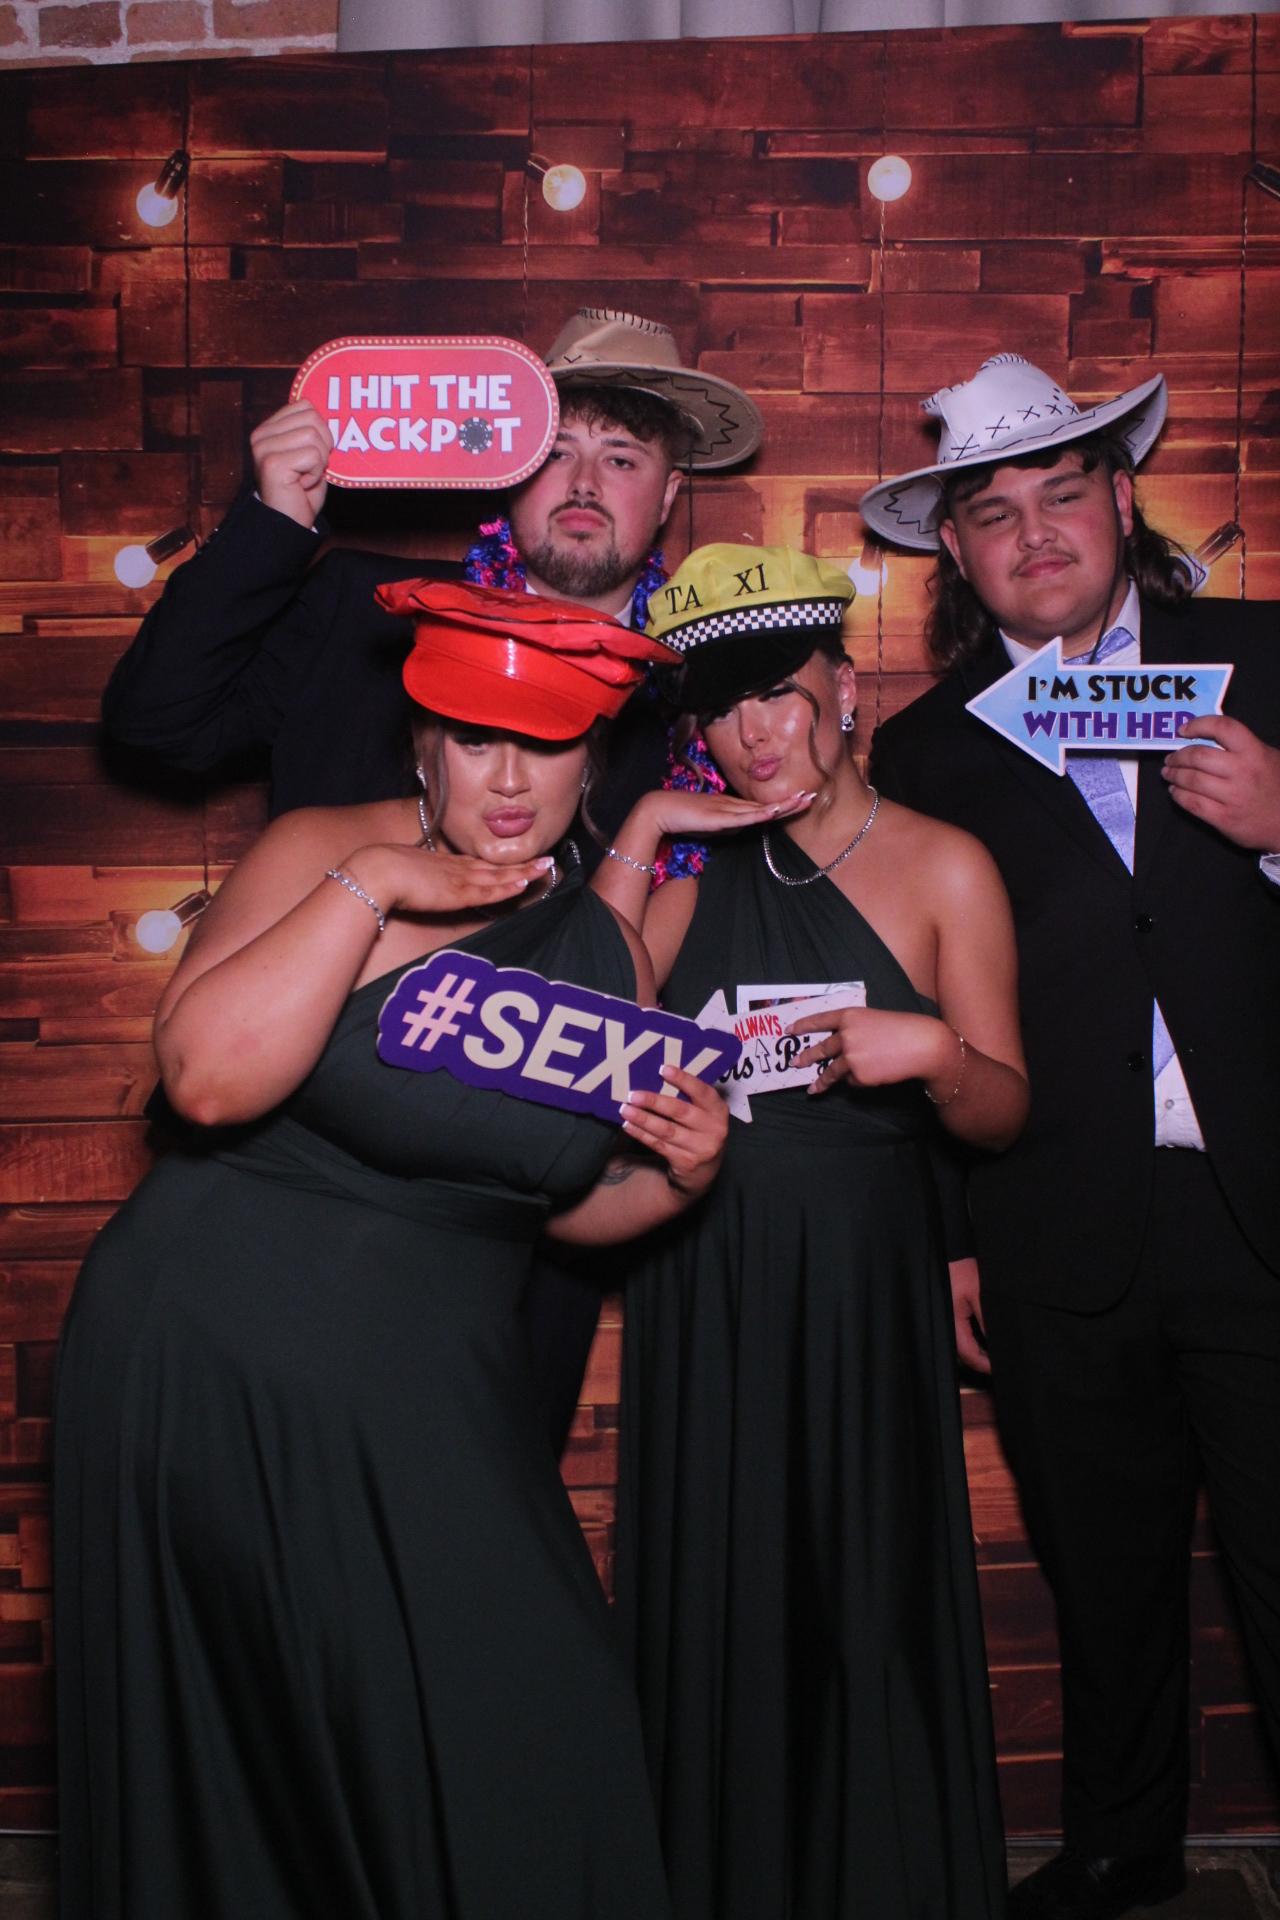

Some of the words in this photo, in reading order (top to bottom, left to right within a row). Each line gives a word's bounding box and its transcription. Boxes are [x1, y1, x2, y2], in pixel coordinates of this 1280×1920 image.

[327, 375, 340, 410] I
[350, 374, 420, 410] HIT
[429, 374, 512, 410] THE
[1027, 675, 1080, 701] I'M
[1088, 674, 1198, 702] STUCK
[1023, 710, 1118, 739] WITH
[401, 973, 722, 1104] #SEXY
[734, 1014, 783, 1042] ALWAYS
